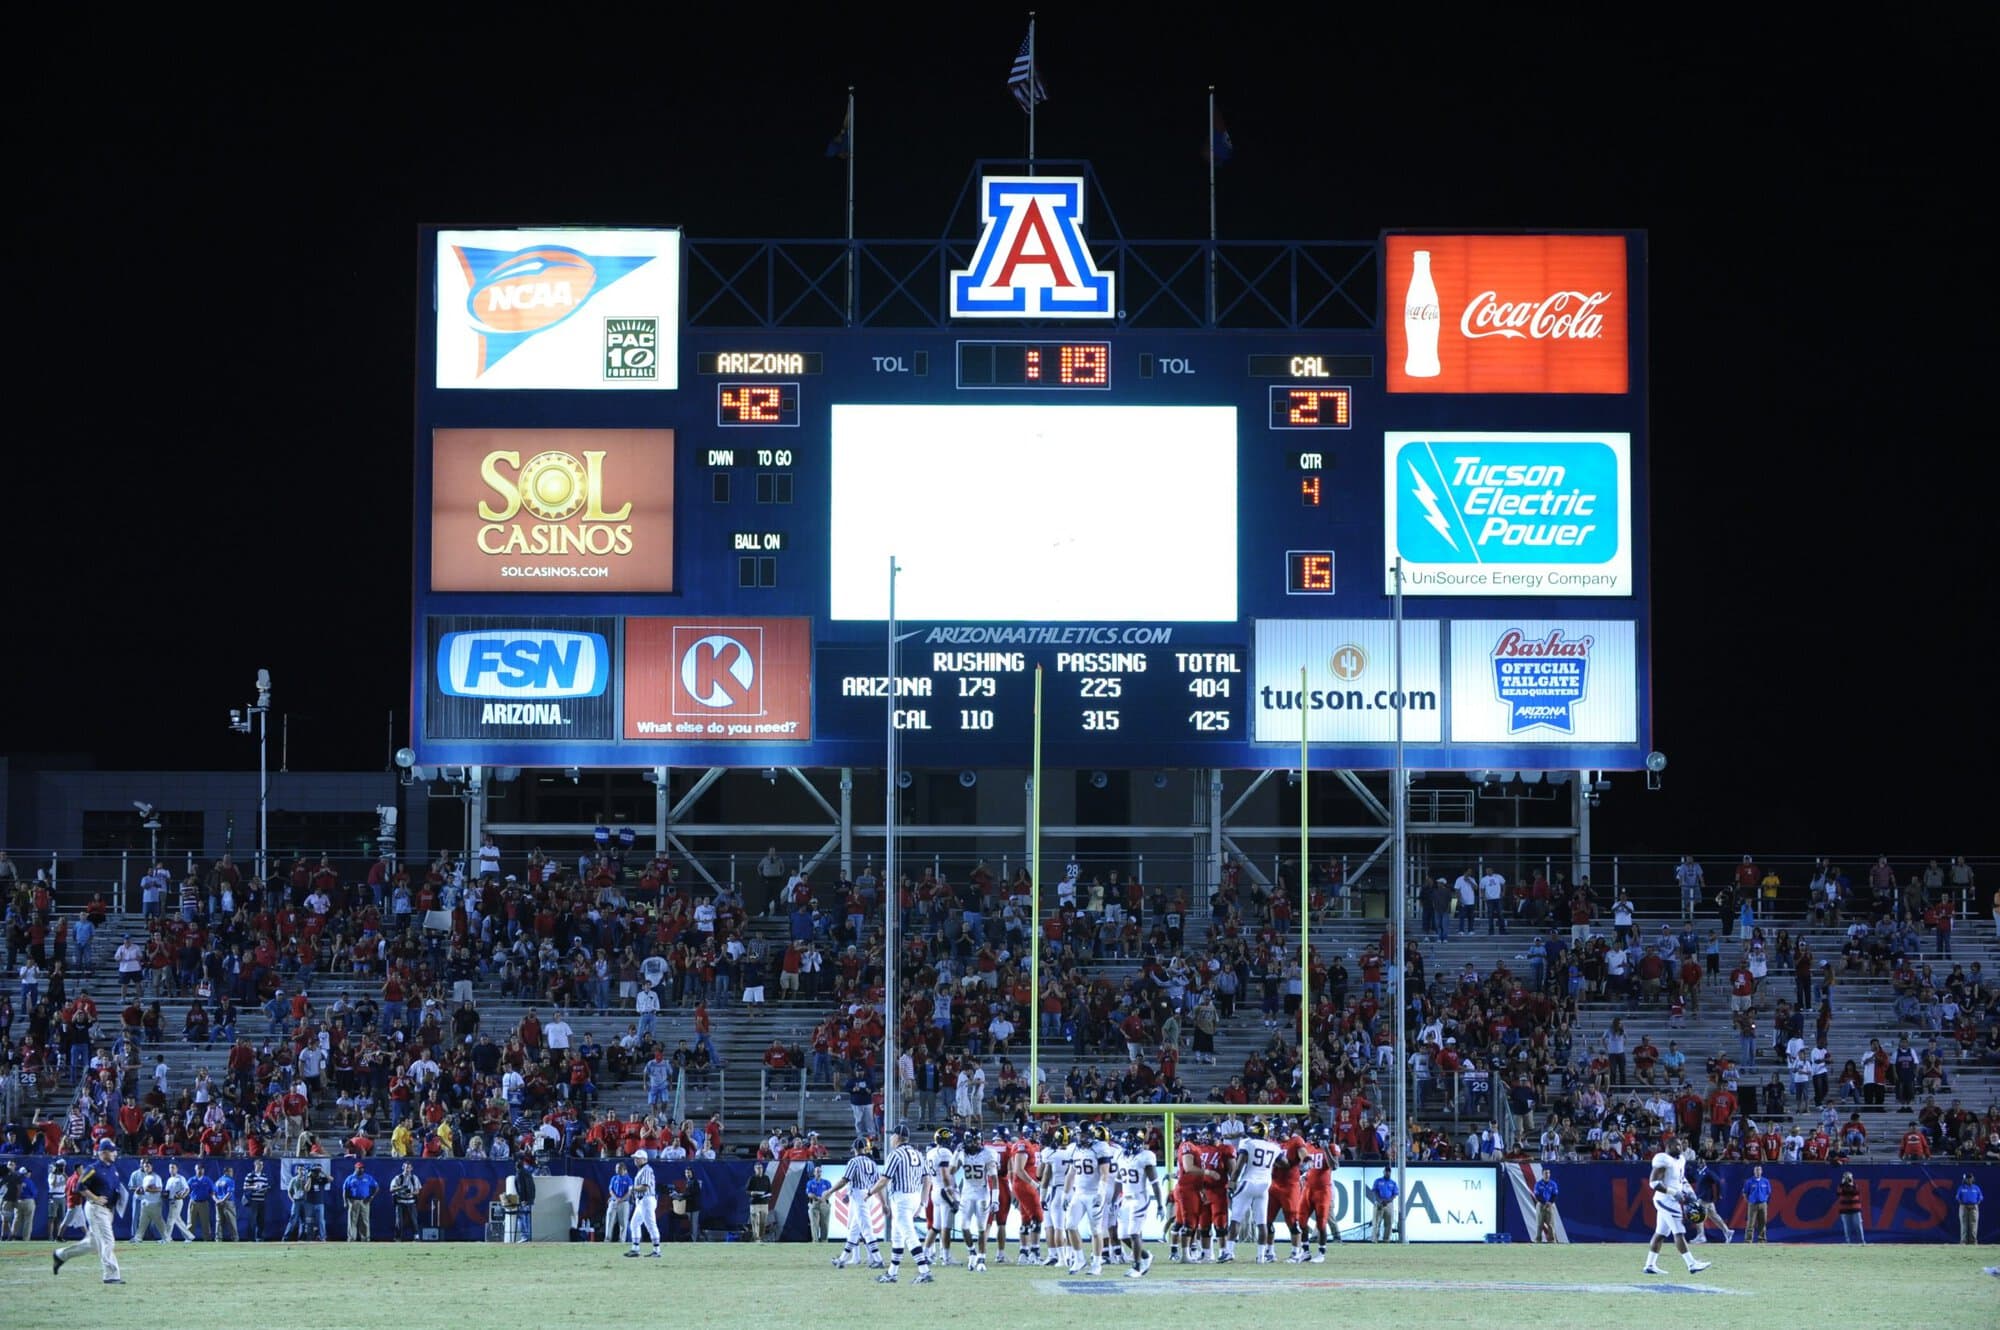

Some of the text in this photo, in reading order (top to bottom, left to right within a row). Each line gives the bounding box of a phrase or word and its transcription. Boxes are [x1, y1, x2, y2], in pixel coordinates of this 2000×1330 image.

[950, 176, 1115, 318] A
[488, 281, 572, 311] NCAA
[1461, 291, 1612, 339] Coca-Cola
[608, 333, 654, 347] PAC
[608, 348, 654, 368] 10
[717, 353, 803, 373] ARIZONA
[872, 357, 909, 372] TOL
[1159, 358, 1195, 374] TOL
[1290, 357, 1330, 377] CAL
[722, 388, 779, 420] 42
[1290, 391, 1347, 423] 27
[708, 451, 733, 466] DWN
[757, 451, 792, 466] TO GO
[1300, 453, 1322, 469] QTR
[1451, 456, 1566, 487] Tucson
[478, 450, 632, 521] SOL
[1303, 477, 1320, 505] 4
[1464, 488, 1596, 516] Electric
[476, 524, 632, 555] CASINOS
[735, 534, 780, 549] BALL ON
[1478, 518, 1596, 545] Power
[501, 567, 608, 577] SOLCASINOS.COM
[1304, 557, 1331, 588] 15
[1412, 571, 1487, 585] UniSource
[1493, 572, 1543, 588] Energy
[1550, 571, 1617, 587] Company
[926, 627, 1172, 644] ARIZONAATHLETICS.COM
[1496, 632, 1590, 656] Bashas'
[464, 639, 581, 688] FSN
[933, 652, 1241, 673] RUSHING PASSING TOTAL
[1502, 663, 1579, 674] OFFICIAL
[842, 677, 1230, 698] ARIZONA 179 225 404
[1502, 676, 1579, 687] TAILGATE
[1260, 685, 1436, 710] tucson.com
[1502, 688, 1579, 697] HEADQUARTERS
[481, 704, 562, 725] ARIZONA
[893, 710, 932, 730] CAL
[960, 710, 993, 730] 110
[1082, 711, 1120, 730] 315
[1516, 706, 1566, 716] ARIZONA
[637, 722, 797, 736] What else do you need?
[1067, 864, 1079, 877] 28
[20, 1073, 37, 1084] 26
[1472, 1081, 1488, 1092] 29
[1252, 1148, 1275, 1168] 97
[963, 1164, 984, 1179] 25
[1464, 1180, 1482, 1190] TM
[1612, 1178, 1953, 1230] WDCATS
[1447, 1211, 1484, 1225] N.A.
